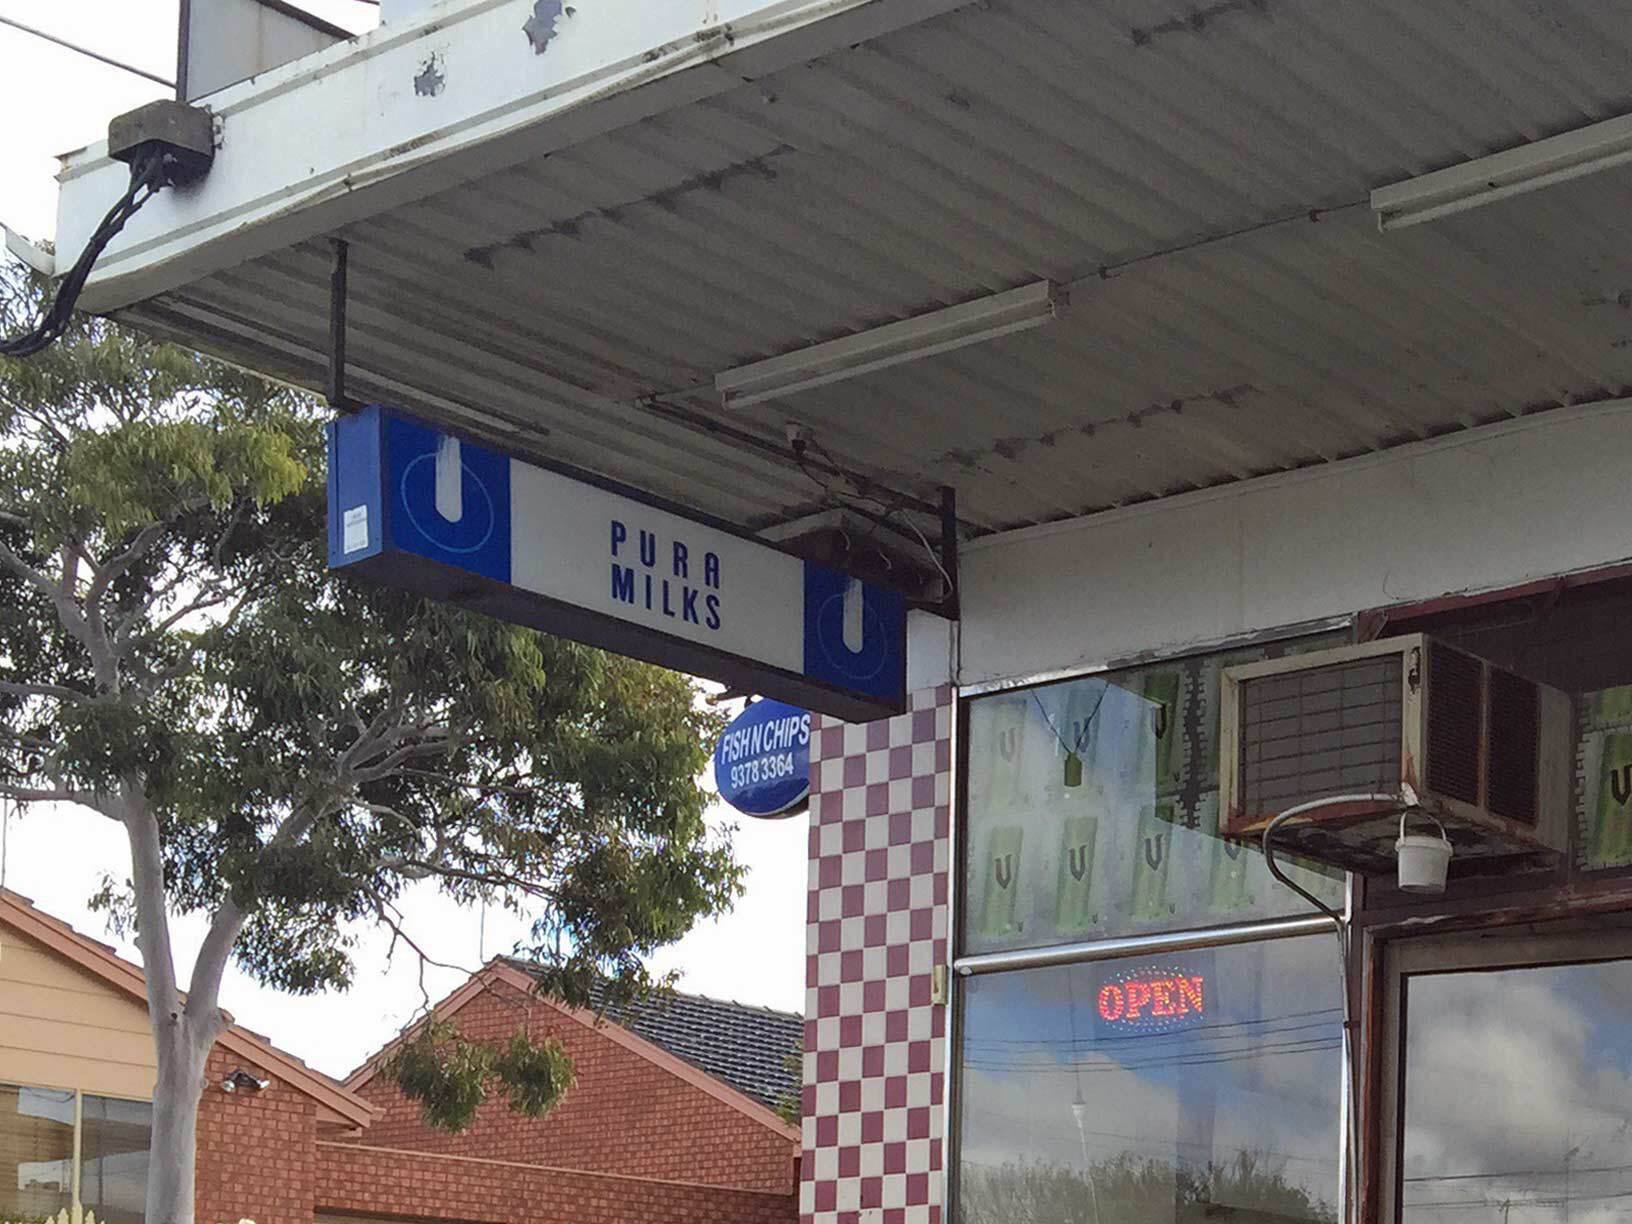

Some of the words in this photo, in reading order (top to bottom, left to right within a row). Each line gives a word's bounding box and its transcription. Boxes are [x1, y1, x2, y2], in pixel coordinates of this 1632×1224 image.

[611, 520, 719, 589] PURA
[611, 563, 720, 630] MILKS
[721, 727, 751, 765] FISH
[751, 723, 763, 755] N
[763, 713, 811, 752] CHIPS
[731, 760, 759, 789] 9378
[761, 752, 794, 780] 3364
[1098, 976, 1204, 1020] OPEN
